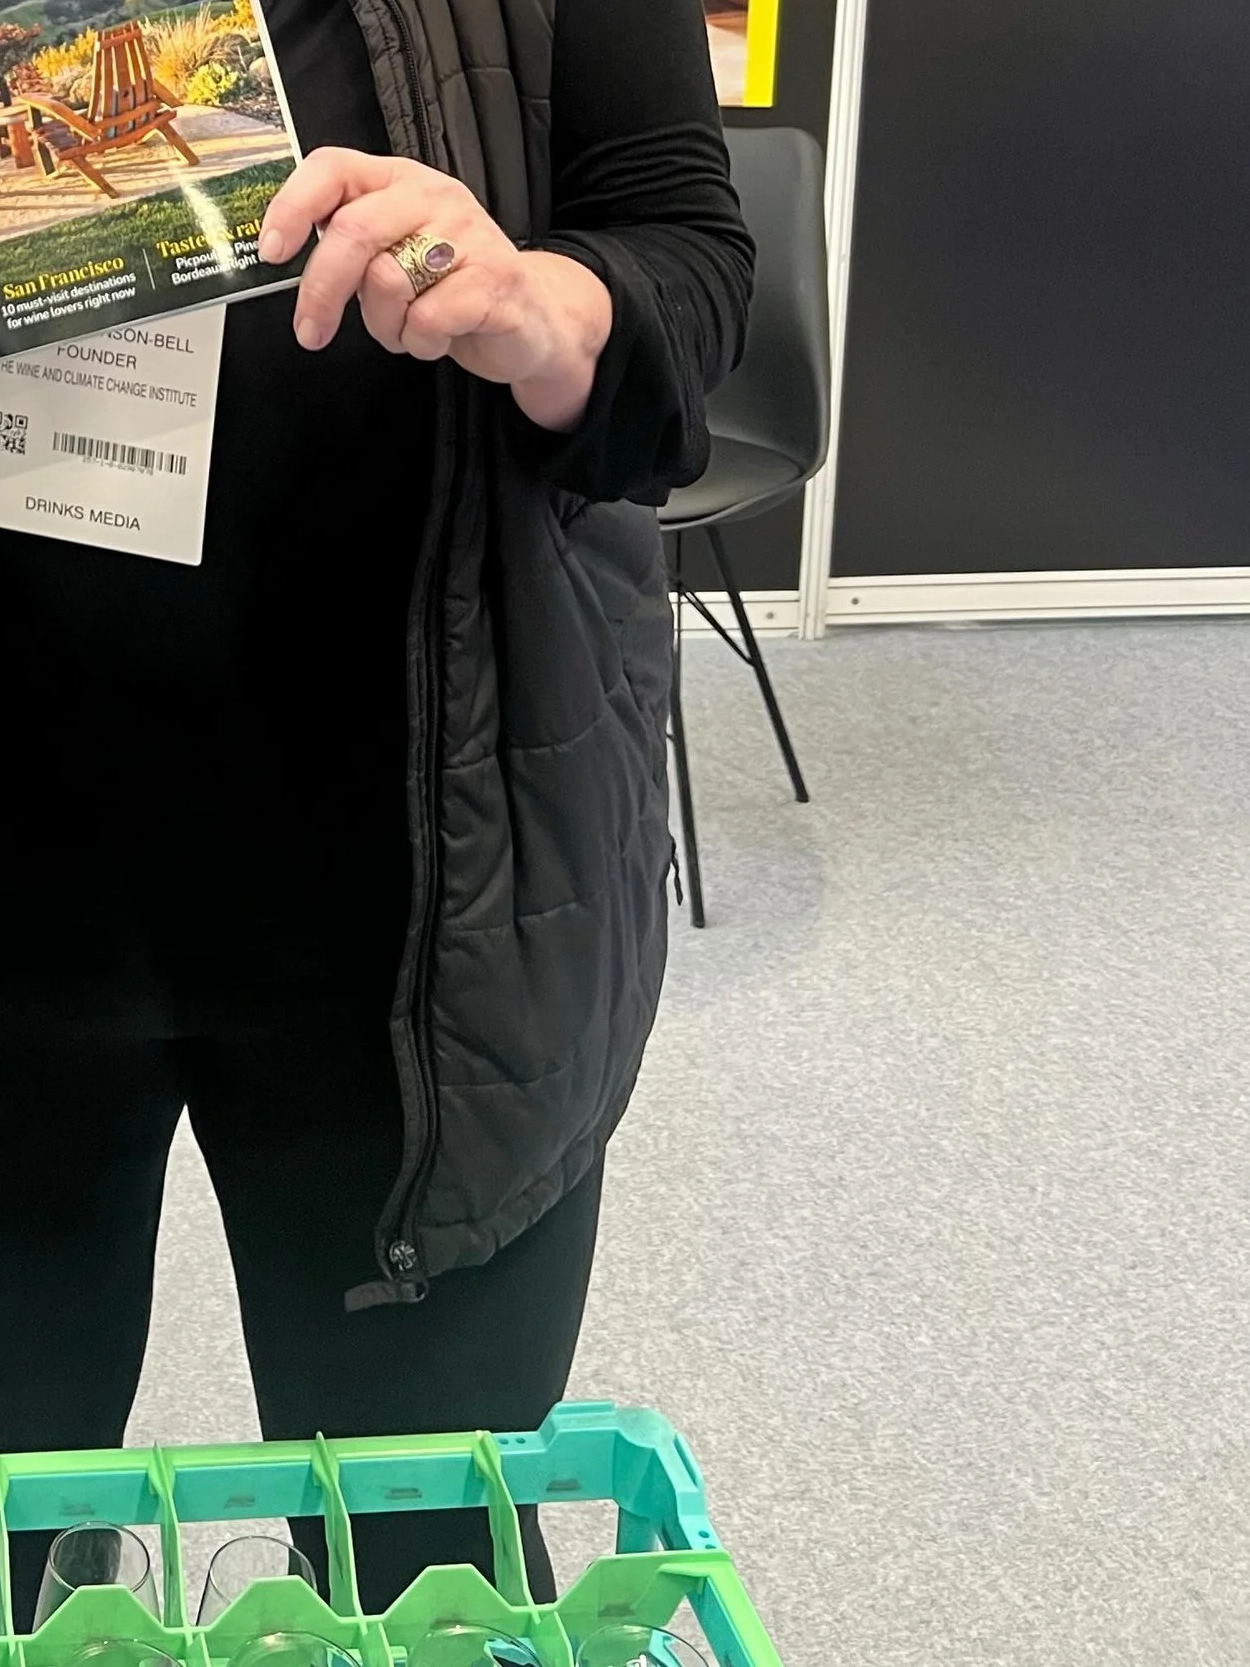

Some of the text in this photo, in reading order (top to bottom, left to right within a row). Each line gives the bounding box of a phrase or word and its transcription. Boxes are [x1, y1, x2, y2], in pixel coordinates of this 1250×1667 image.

[1, 272, 136, 318] 10 must-visit destinations
[3, 256, 125, 300] San Francisco
[171, 263, 225, 285] Bordeaux
[7, 287, 136, 330] for wine lovers right now
[57, 344, 138, 370] FOUNDER
[16, 361, 41, 379] WINE
[42, 366, 63, 382] AND
[64, 370, 105, 391] CLIMATE
[106, 378, 148, 398] CHANGE
[149, 385, 198, 408] INSTITUTE
[25, 495, 141, 532] DRINKS MEDIA
